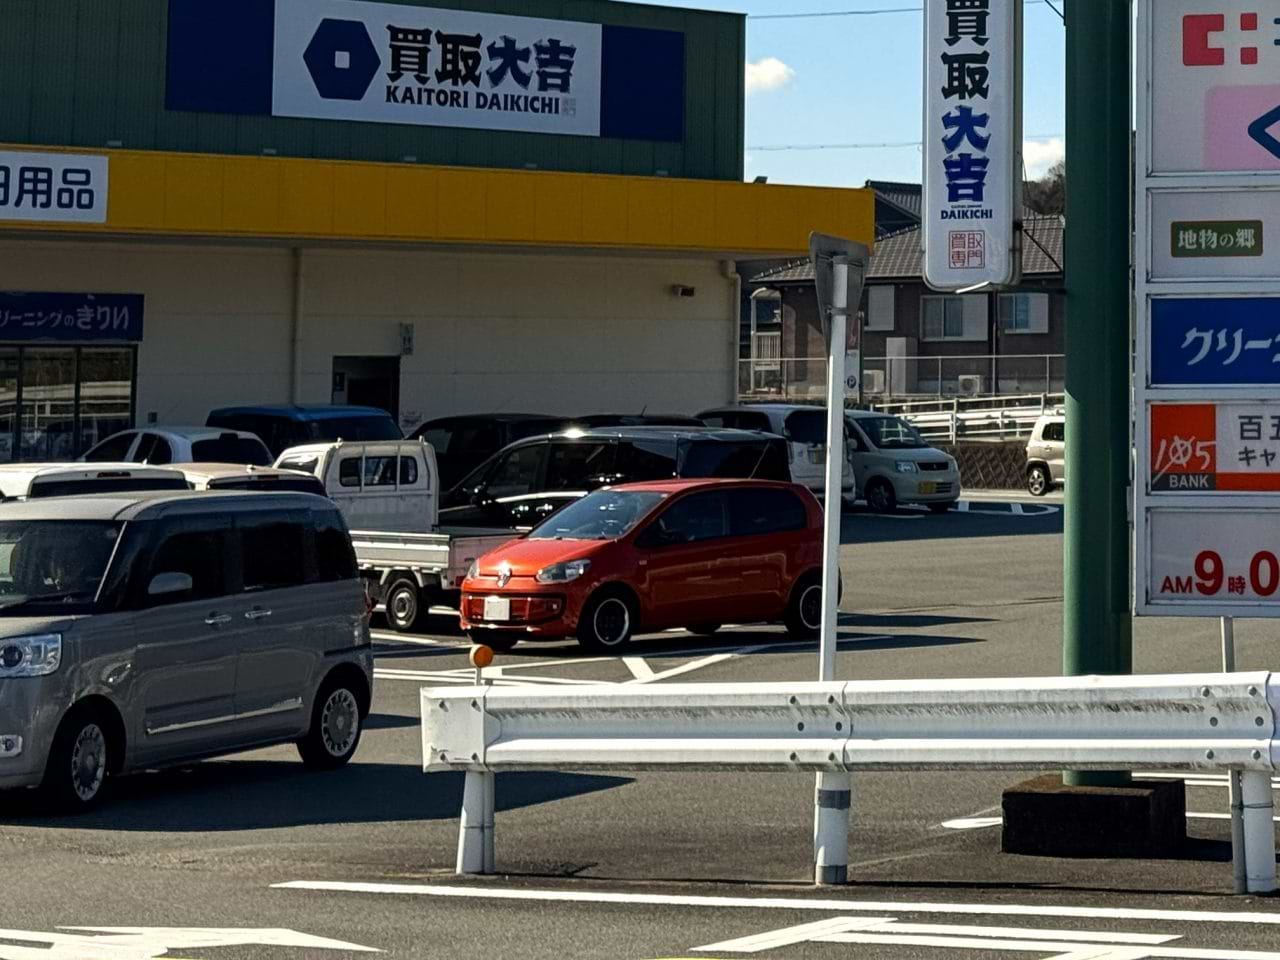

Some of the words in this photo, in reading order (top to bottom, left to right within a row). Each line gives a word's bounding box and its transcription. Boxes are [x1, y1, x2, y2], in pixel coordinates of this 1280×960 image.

[383, 23, 578, 94] 買取大吉
[385, 84, 469, 109] KAITORI
[474, 91, 560, 115] DAIKICHI
[940, 208, 993, 220] DAIKICHI
[1177, 229, 1256, 250] 地物の郷
[1169, 474, 1209, 489] BANK
